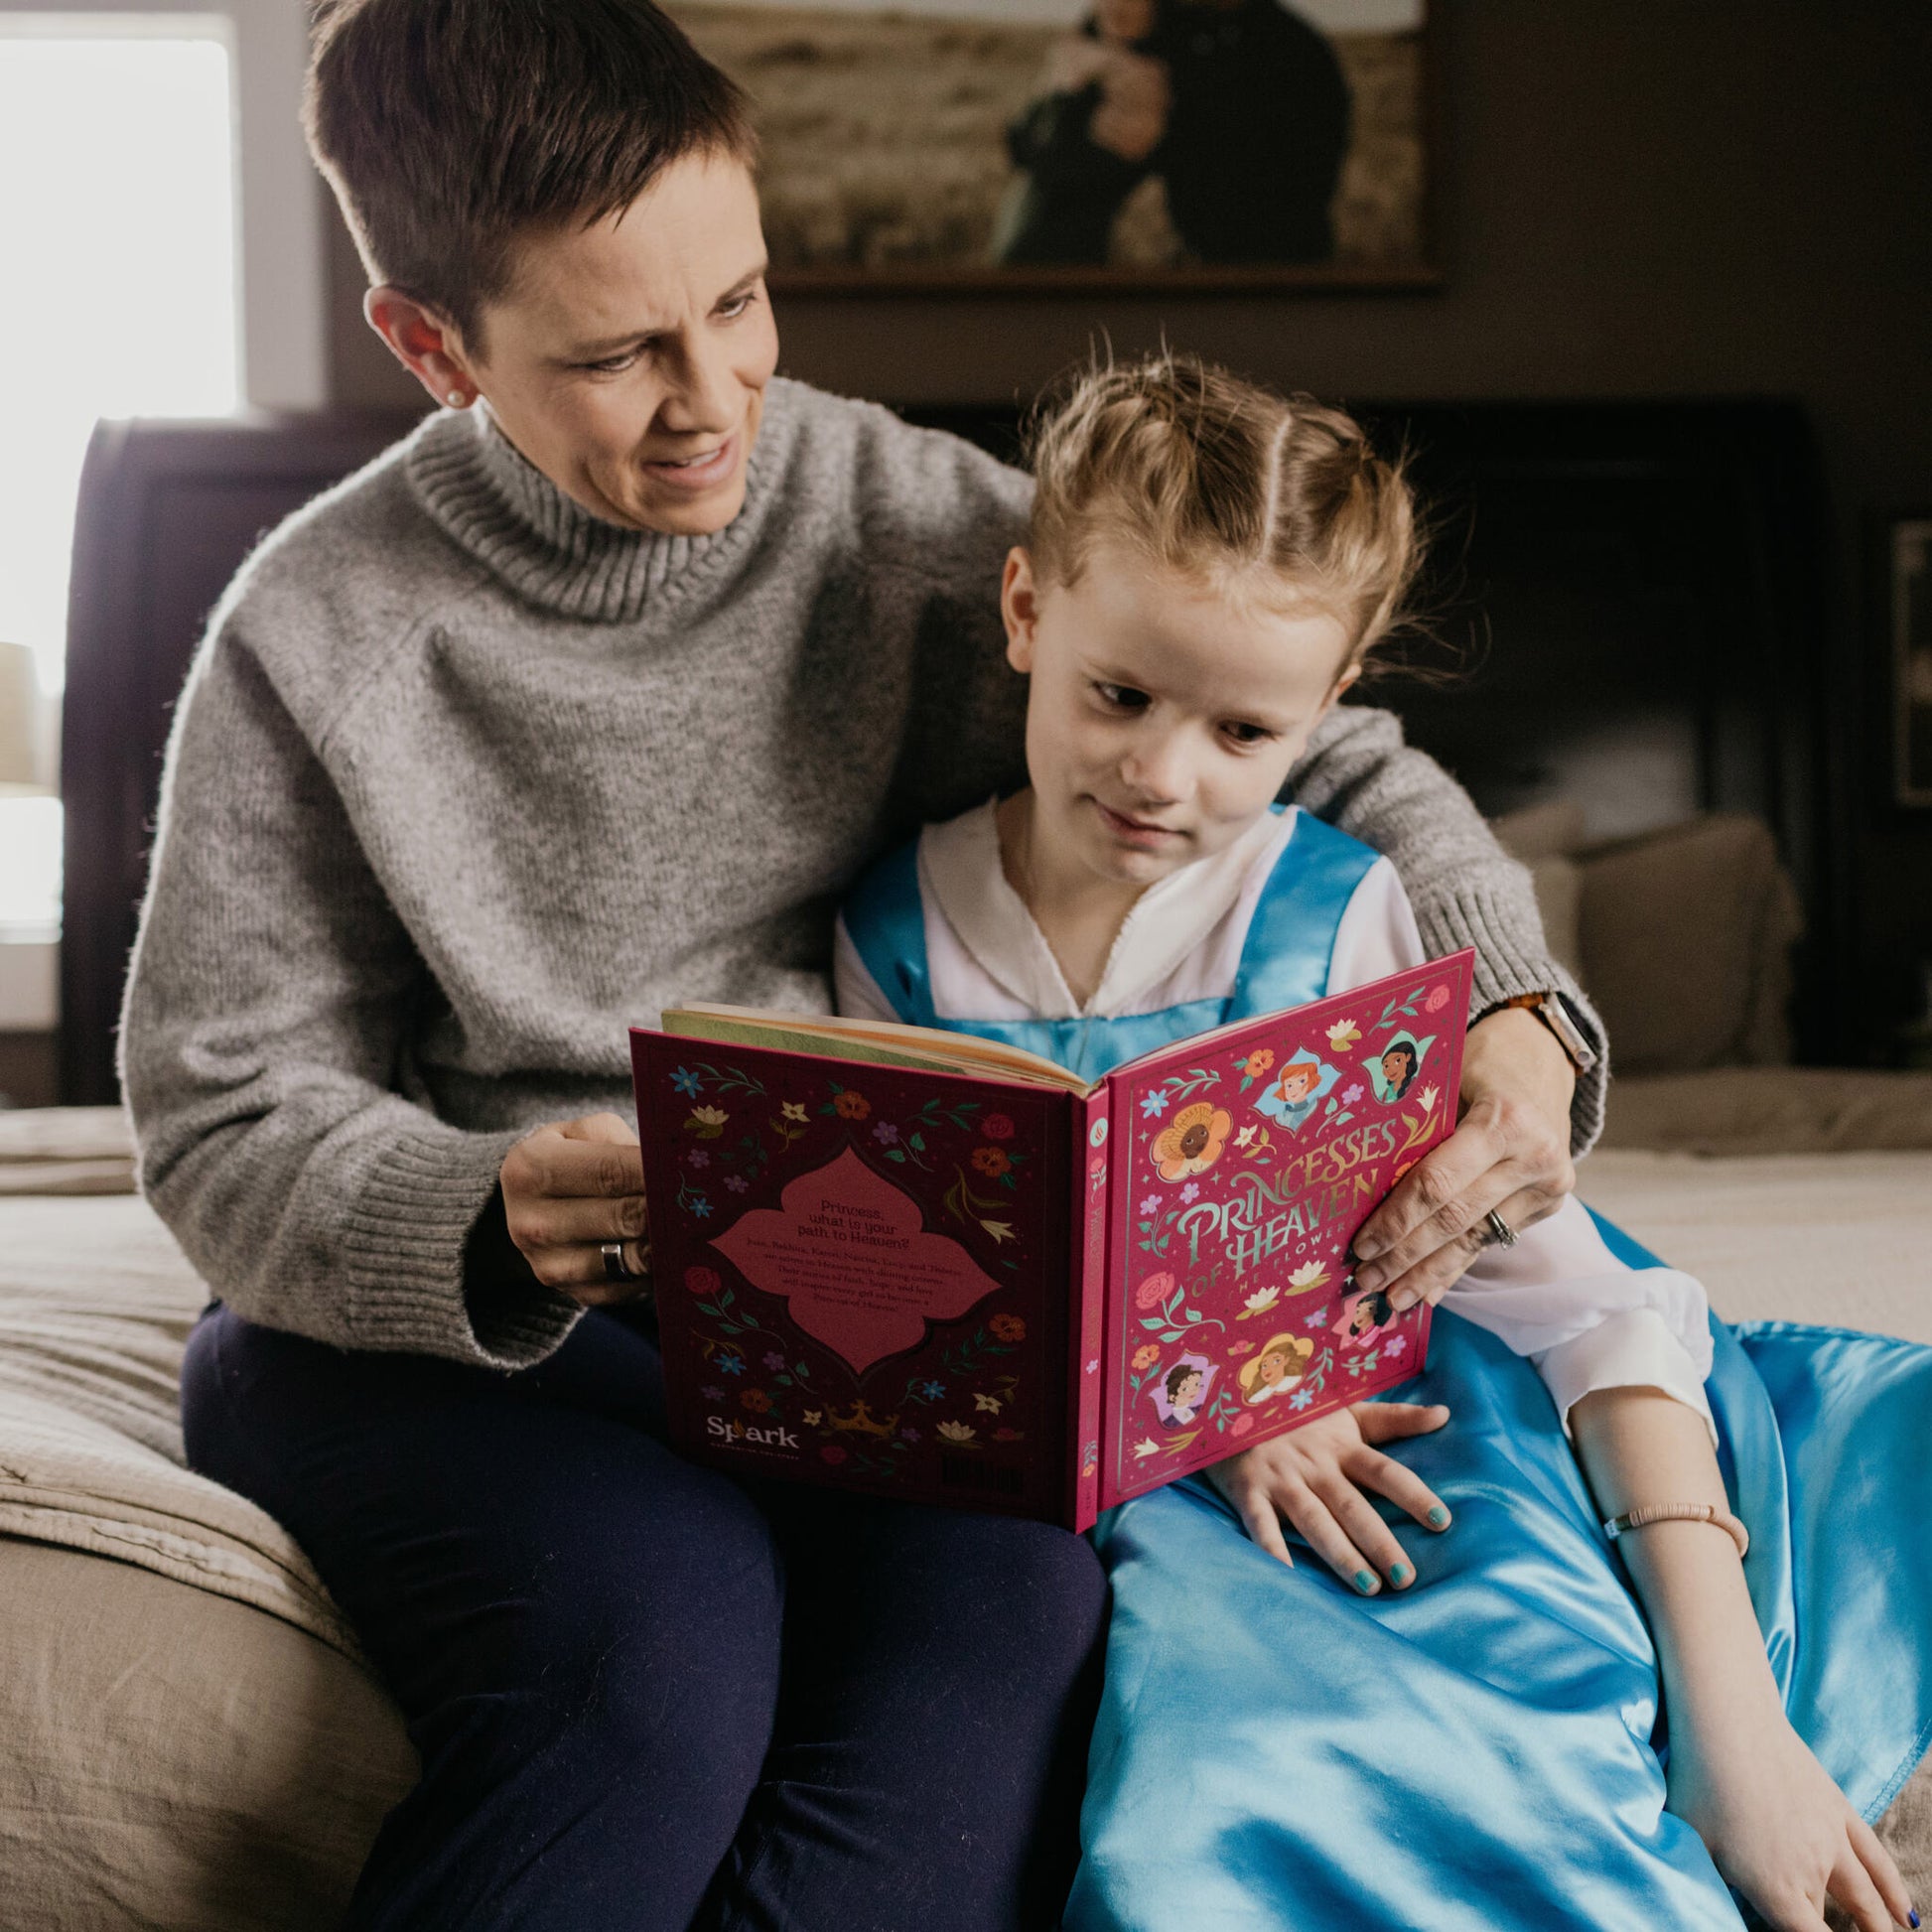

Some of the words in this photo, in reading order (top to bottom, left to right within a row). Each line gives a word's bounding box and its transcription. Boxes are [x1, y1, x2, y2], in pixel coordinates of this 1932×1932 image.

[1176, 1118, 1397, 1269] PRINCESSES
[797, 1225, 830, 1238] path
[833, 1231, 848, 1242] to
[850, 1231, 909, 1250] Heaven?
[809, 1213, 844, 1228] what
[848, 1218, 862, 1230] is
[865, 1221, 898, 1236] your
[1191, 1261, 1224, 1298] OF
[1225, 1168, 1379, 1282] HEAVEN
[707, 1416, 799, 1449] Spark
